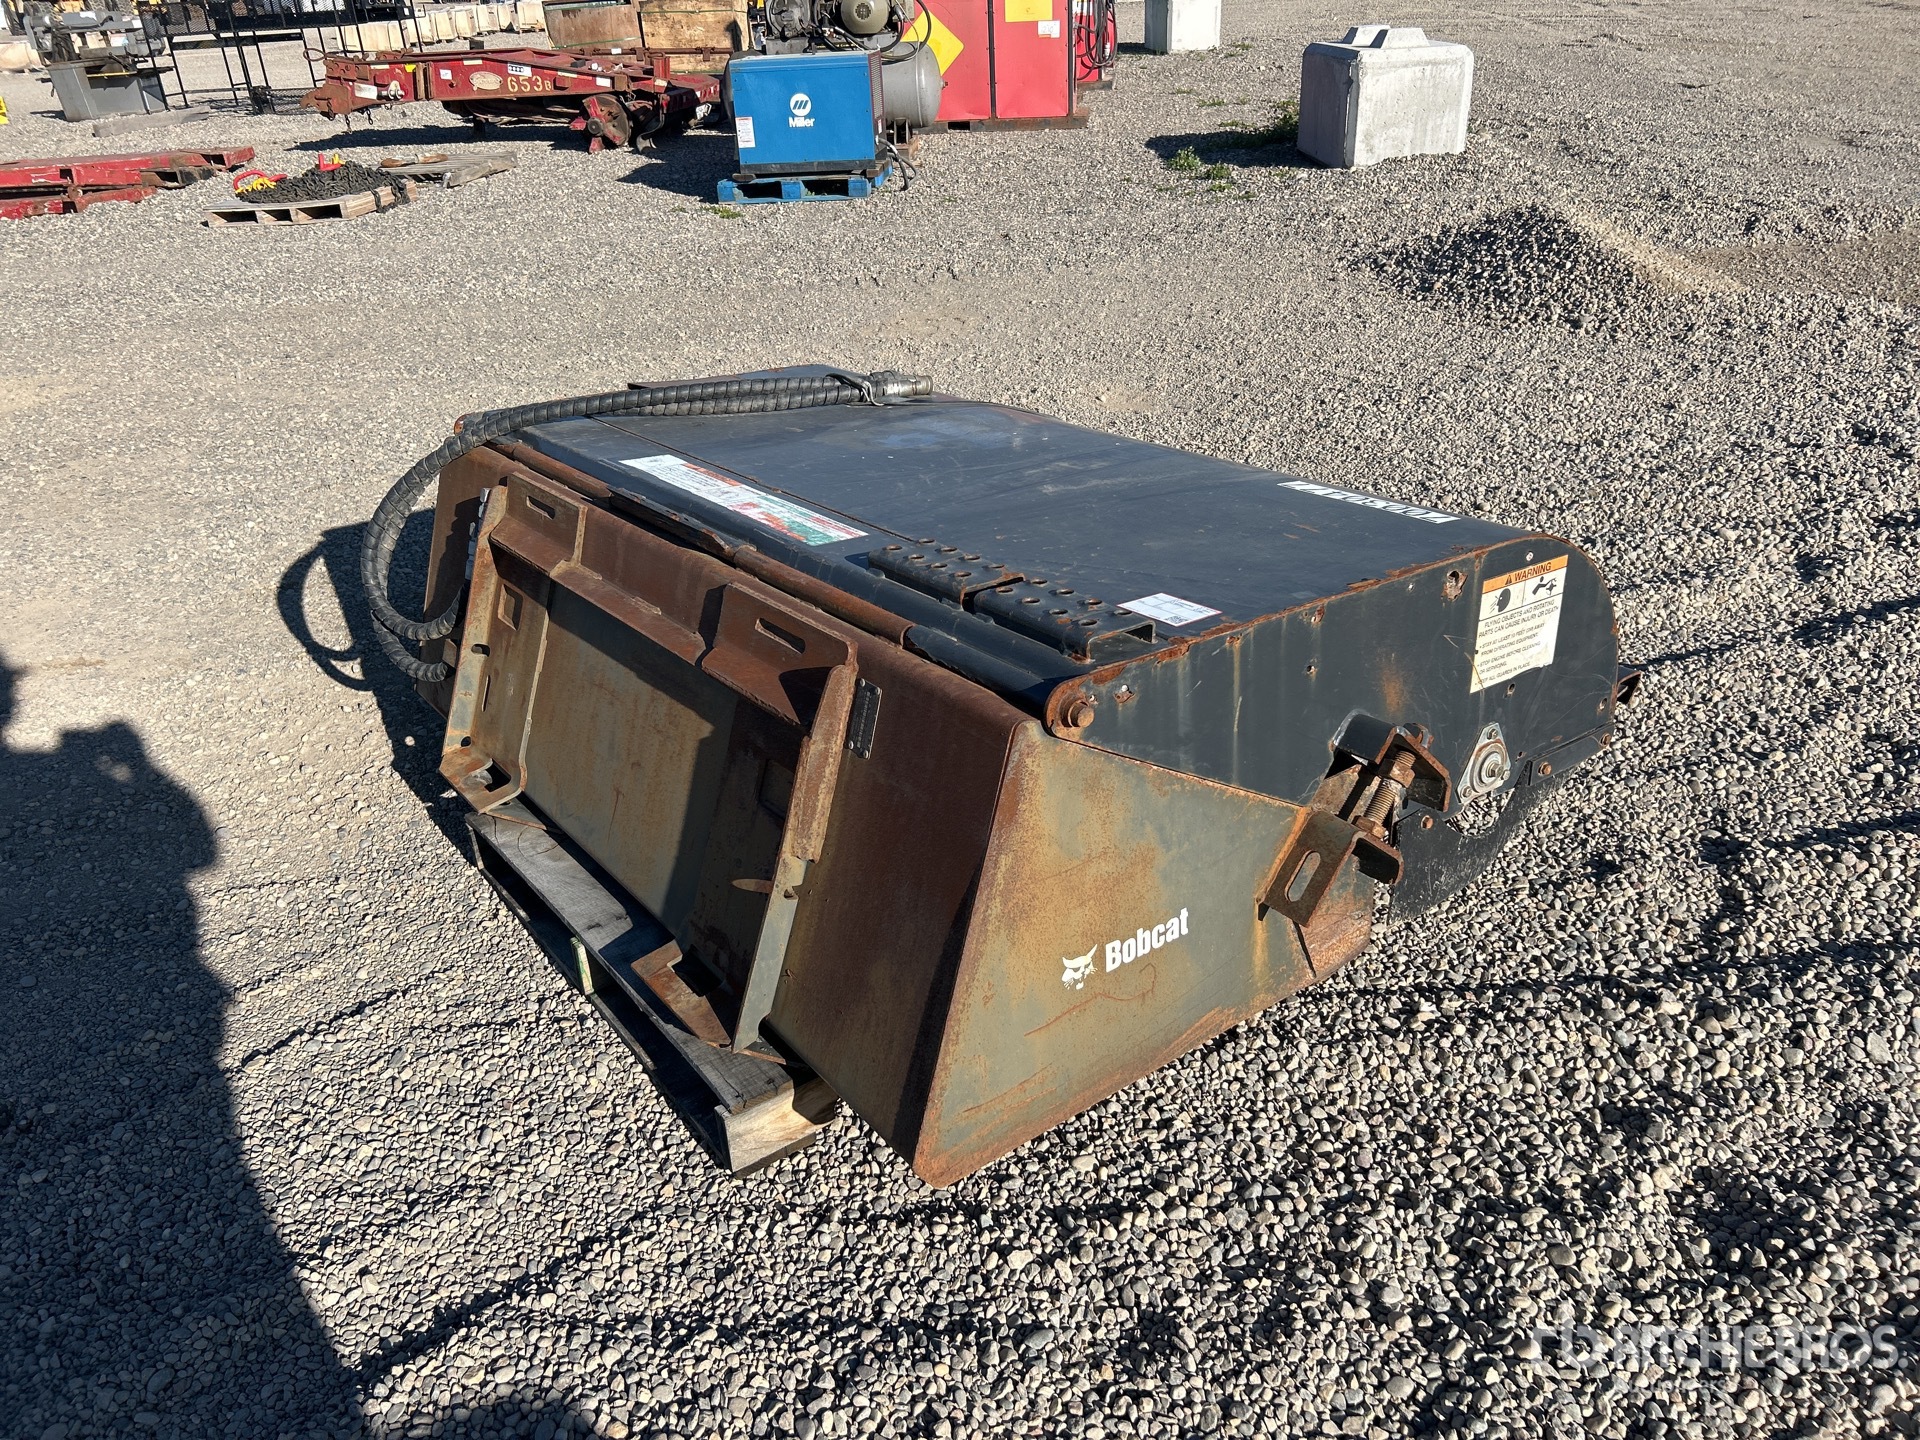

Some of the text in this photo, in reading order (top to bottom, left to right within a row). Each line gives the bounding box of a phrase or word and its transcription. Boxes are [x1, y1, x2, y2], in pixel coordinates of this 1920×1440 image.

[788, 116, 815, 127] Miller
[1513, 561, 1551, 582] WARNING
[1478, 628, 1493, 638] PARTS
[1494, 624, 1504, 633] CAN
[1504, 618, 1520, 629] CAUSE
[1544, 605, 1558, 615] DEATH
[1484, 617, 1500, 628] FLYING
[1501, 609, 1522, 622] OBJECTS
[1533, 599, 1554, 611] ROTATING
[1105, 907, 1189, 973] Bobcat
